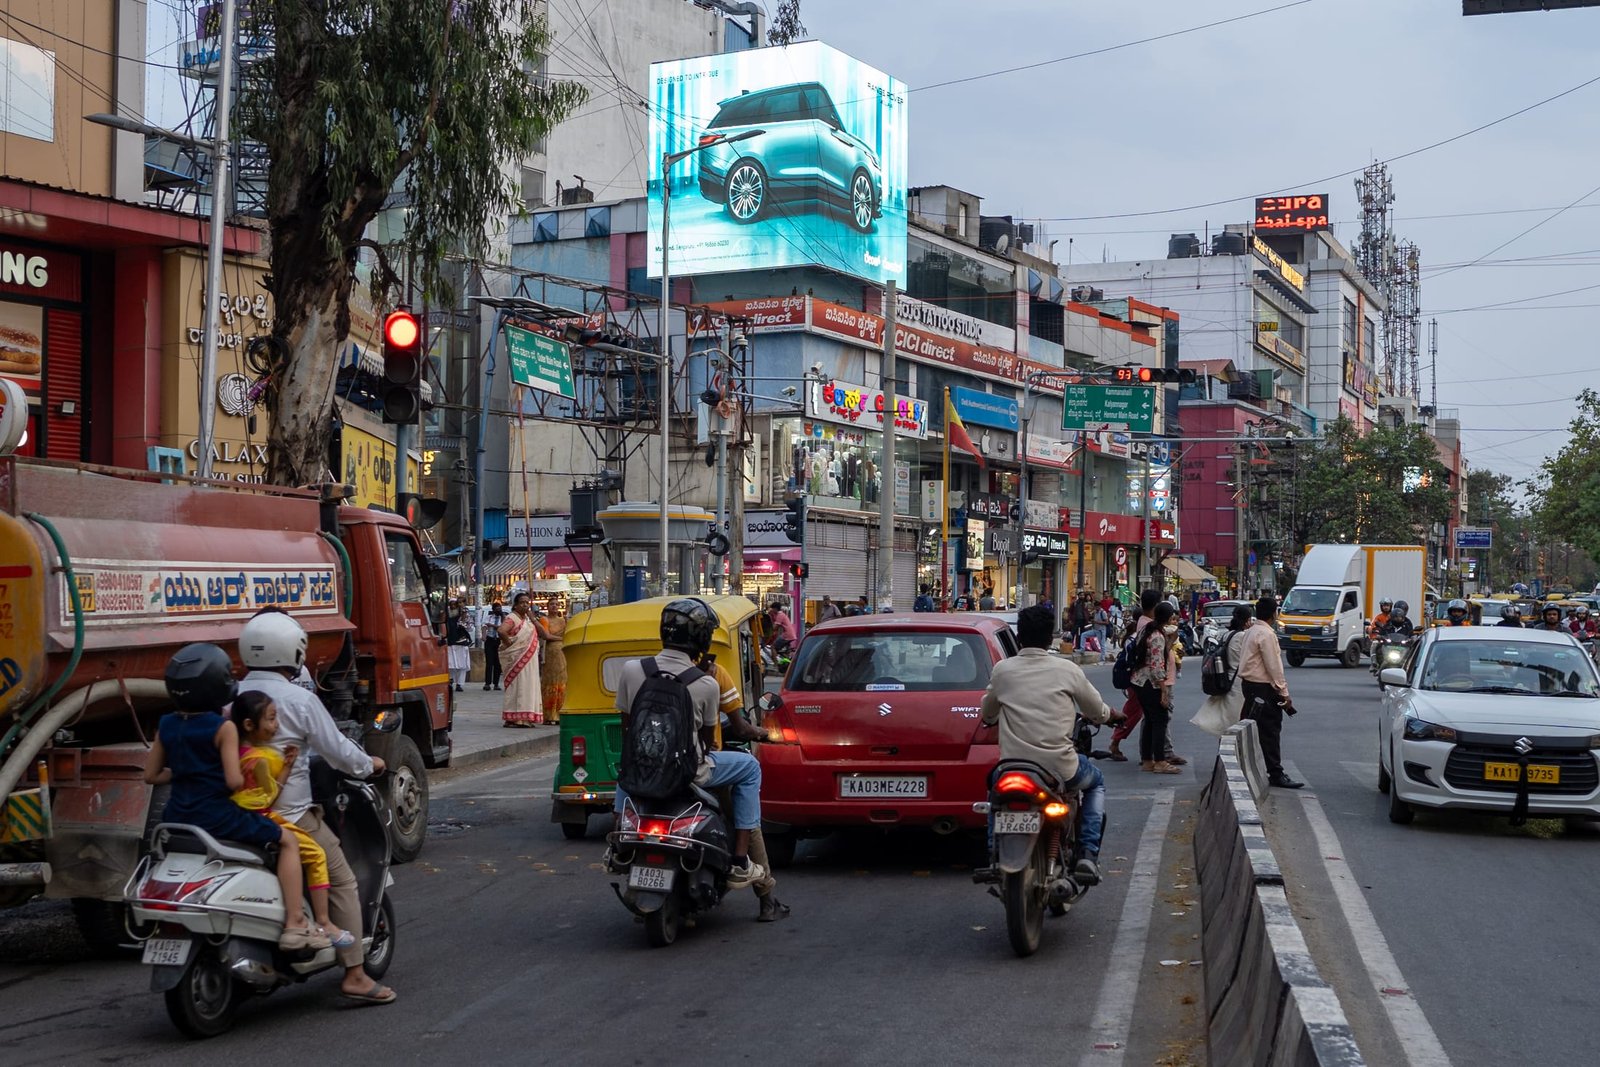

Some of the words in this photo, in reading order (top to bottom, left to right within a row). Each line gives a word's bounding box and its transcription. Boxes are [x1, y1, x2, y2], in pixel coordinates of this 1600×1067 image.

[1296, 214, 1328, 230] spa
[0, 250, 48, 288] NG
[895, 300, 921, 321] MOJO
[921, 307, 956, 331] TATTOO
[956, 318, 983, 339] STUDIO
[895, 329, 920, 352] CICI
[920, 338, 955, 361] direct
[1118, 369, 1132, 380] 93
[875, 394, 920, 421] CLORS
[514, 527, 553, 538] FAHION
[555, 527, 563, 537] &
[849, 780, 925, 794] KA03ME4228
[1004, 814, 1015, 823] TS
